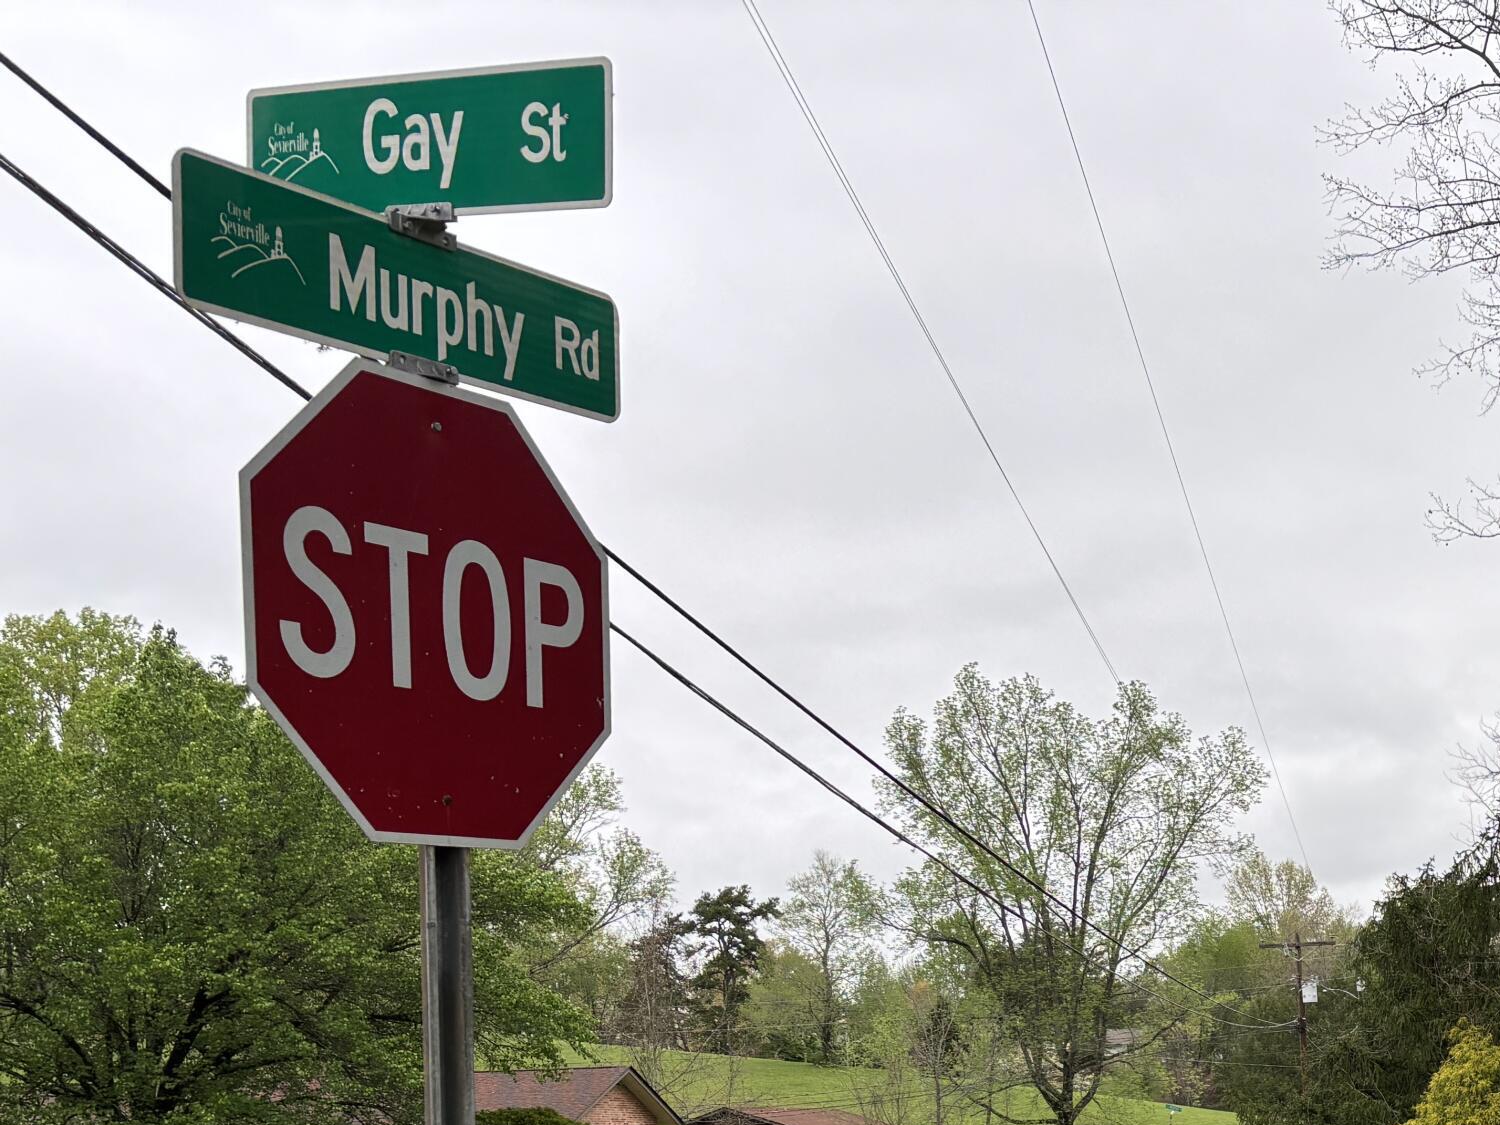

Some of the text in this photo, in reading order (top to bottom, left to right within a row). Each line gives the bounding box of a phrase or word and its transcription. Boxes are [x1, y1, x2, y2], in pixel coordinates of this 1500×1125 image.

[268, 132, 309, 156] Sevierville
[274, 121, 295, 139] City of
[362, 97, 569, 190] Gay St
[228, 200, 252, 221] City of
[220, 213, 270, 246] Sevierville
[329, 233, 601, 381] Murphy Rd
[279, 505, 585, 709] STOP
